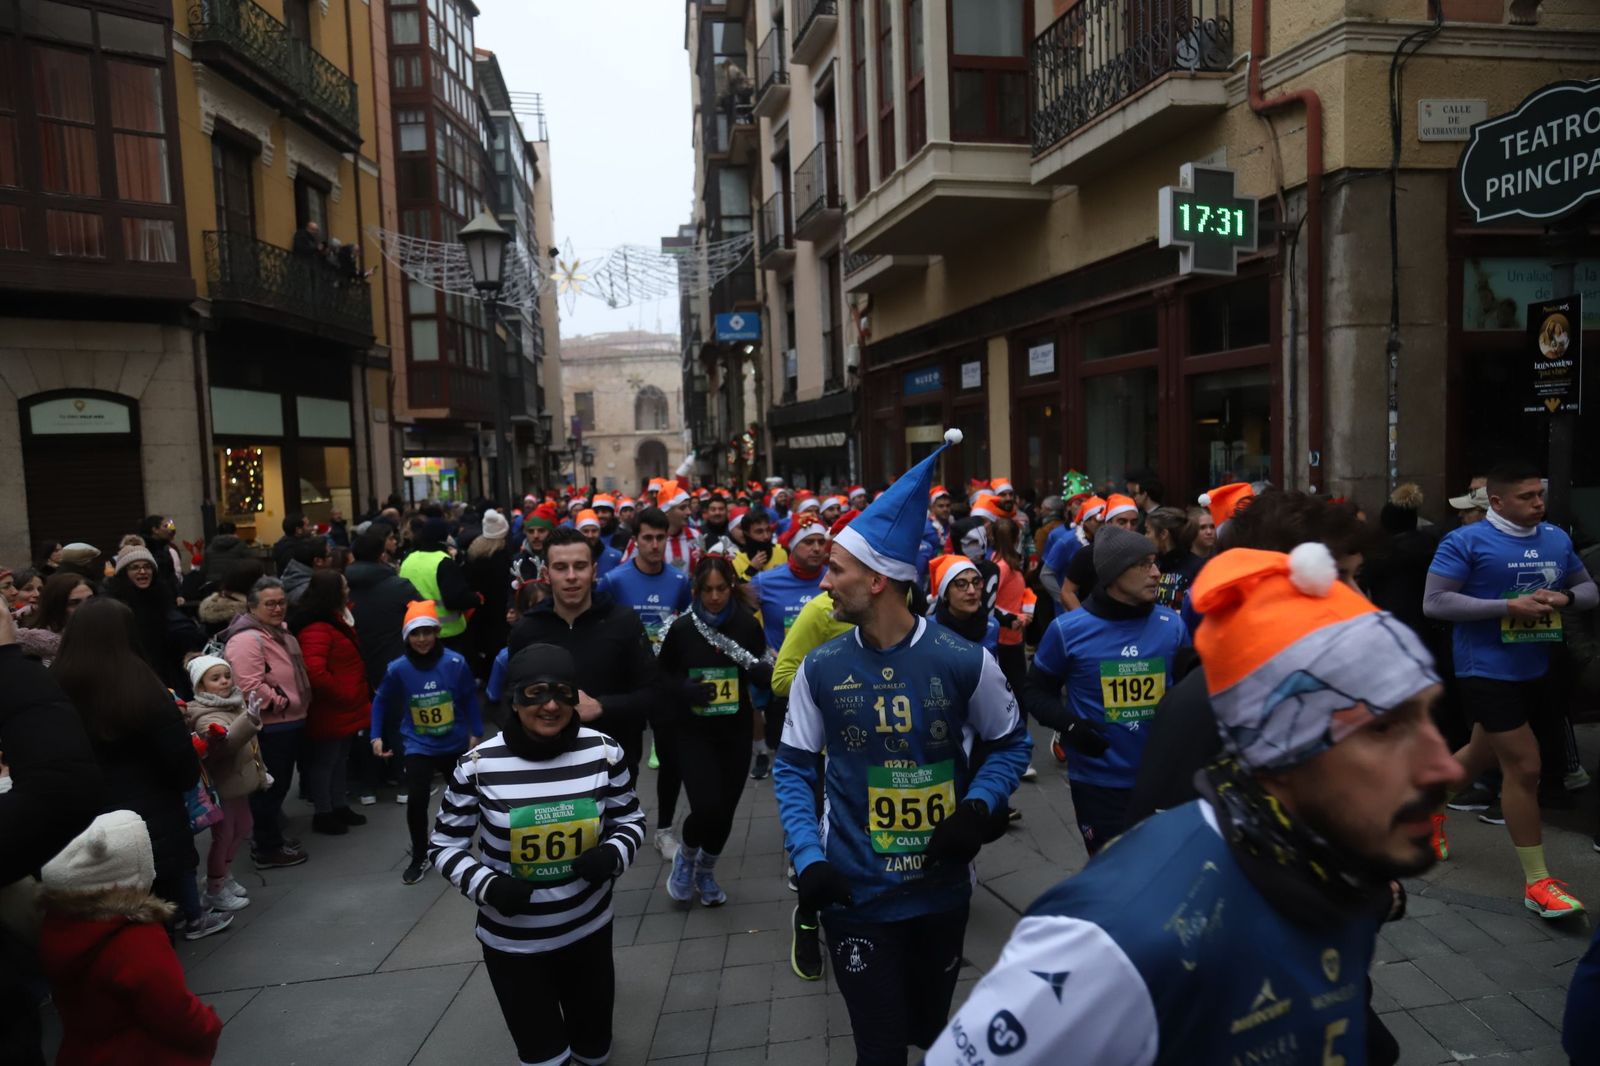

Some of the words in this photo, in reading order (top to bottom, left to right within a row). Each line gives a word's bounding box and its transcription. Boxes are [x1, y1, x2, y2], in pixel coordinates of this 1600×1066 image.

[1442, 105, 1471, 113] CALLE
[1448, 116, 1460, 125] DE
[1500, 106, 1600, 160] TEATRO
[1180, 204, 1243, 236] 17:31
[1524, 550, 1538, 558] 46
[647, 594, 660, 603] 46
[1121, 646, 1139, 657] 46
[423, 681, 437, 690] 46
[833, 683, 862, 691] MERCURY
[1109, 678, 1155, 703] 1192
[419, 707, 442, 724] 68
[873, 695, 913, 733] 19
[1122, 710, 1139, 718] CAJA
[534, 811, 552, 820] CAJA
[552, 809, 575, 818] RURAL
[875, 794, 945, 829] 956
[520, 827, 583, 863] 561
[896, 836, 921, 846] CAJA
[536, 867, 560, 876] CAJA
